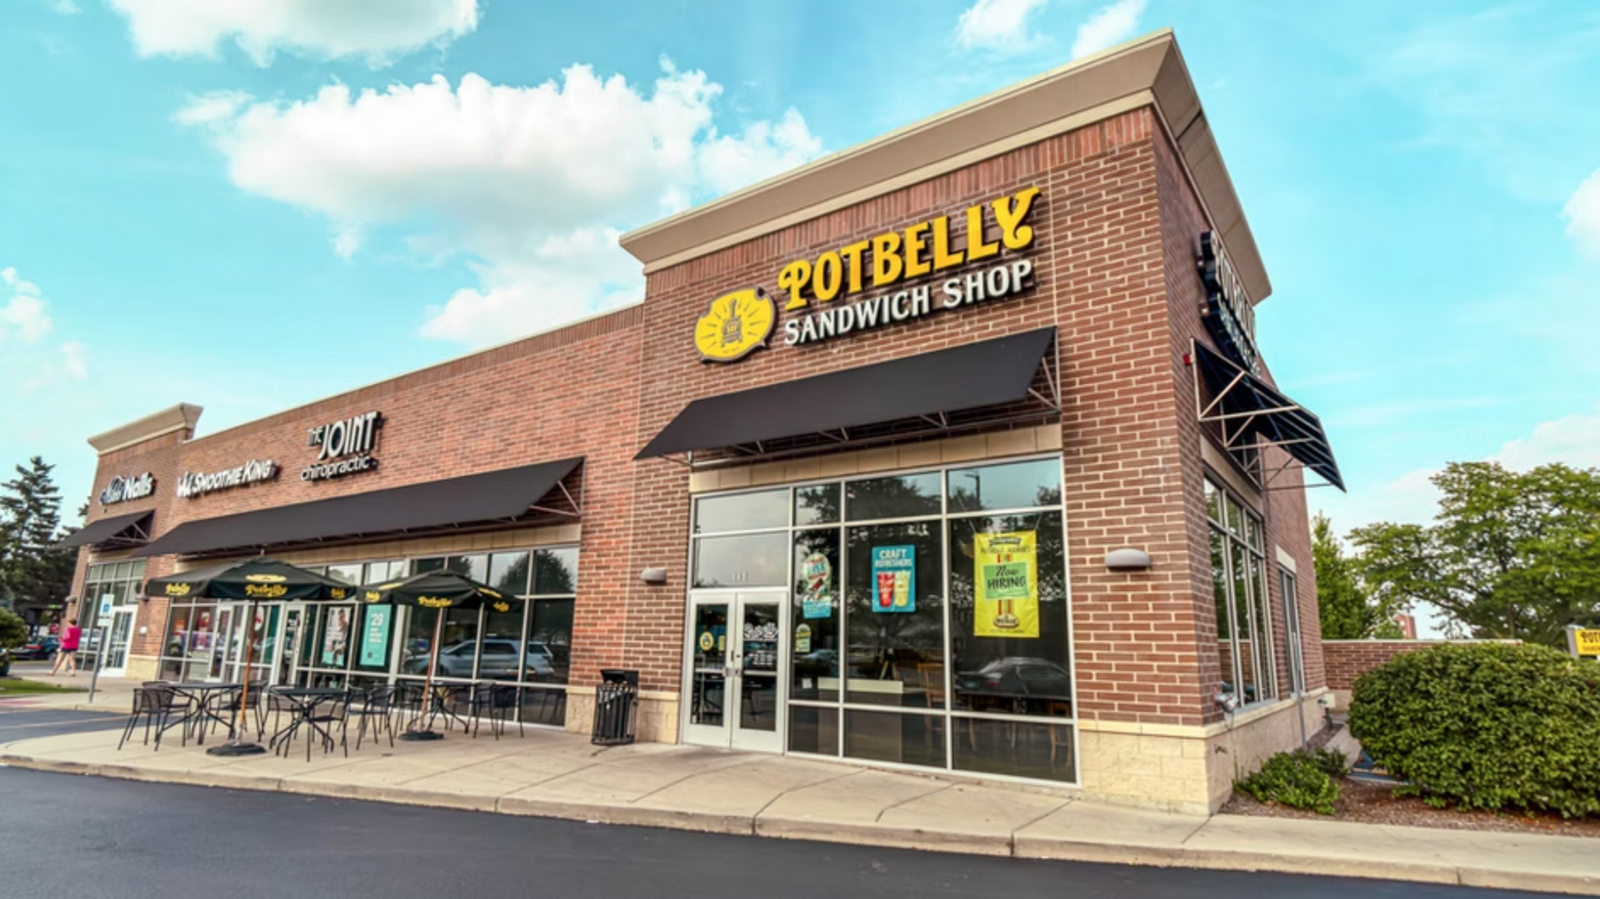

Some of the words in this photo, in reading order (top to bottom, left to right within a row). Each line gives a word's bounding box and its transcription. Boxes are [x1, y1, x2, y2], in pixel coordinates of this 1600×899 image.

[778, 187, 1040, 311] POTBELLY
[784, 286, 930, 347] SANDWICH
[943, 260, 1033, 308] SHOP
[317, 411, 377, 460] JOINT
[300, 454, 371, 481] chiropractic
[880, 548, 907, 559] CRAFT
[987, 576, 1026, 589] HIRING
